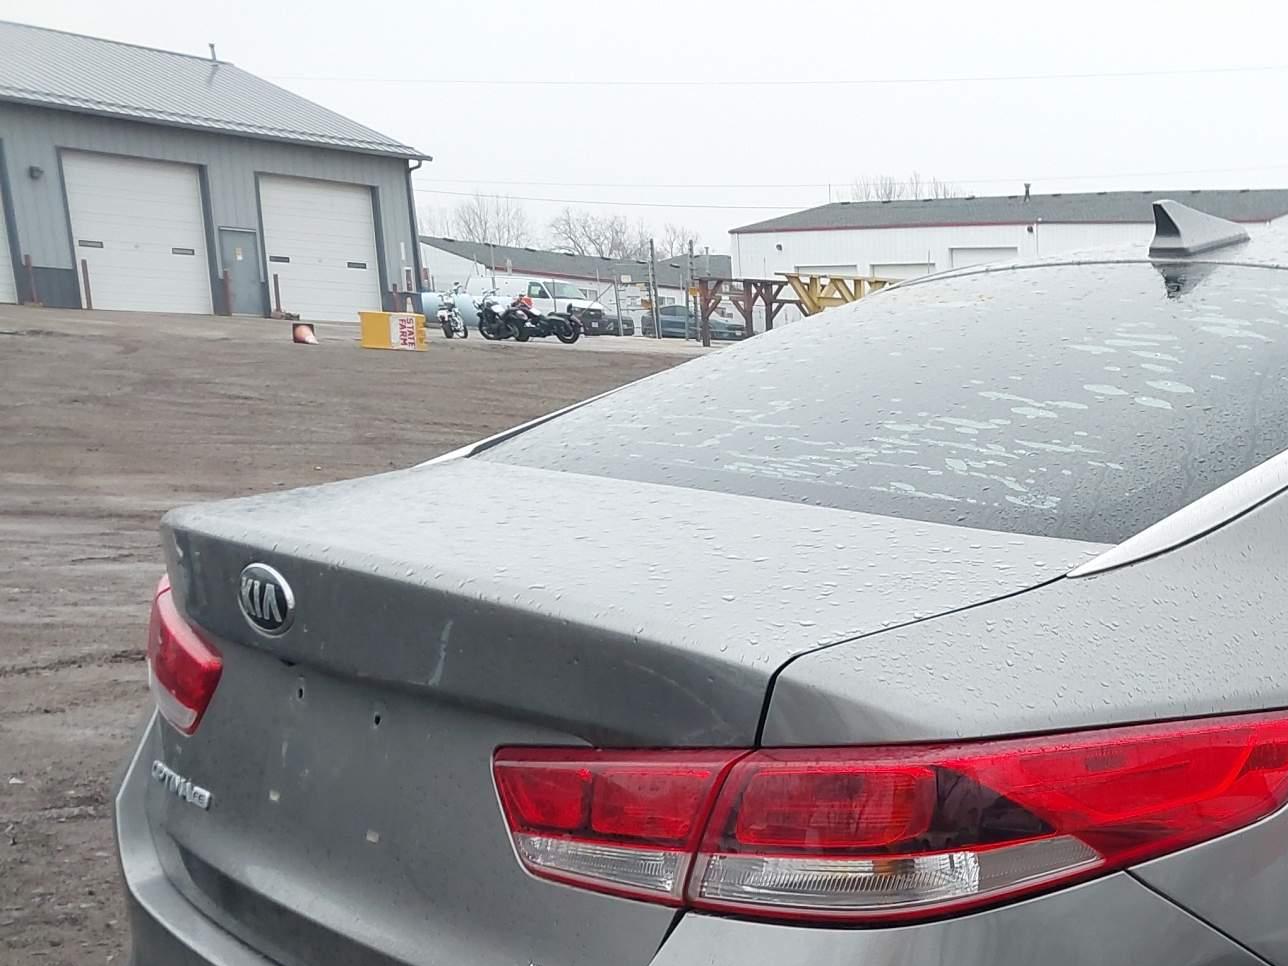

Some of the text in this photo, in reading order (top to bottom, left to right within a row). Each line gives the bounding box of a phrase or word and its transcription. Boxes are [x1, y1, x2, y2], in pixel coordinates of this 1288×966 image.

[399, 318, 408, 346] FARM
[407, 317, 416, 349] STATE
[242, 576, 283, 622] KIA
